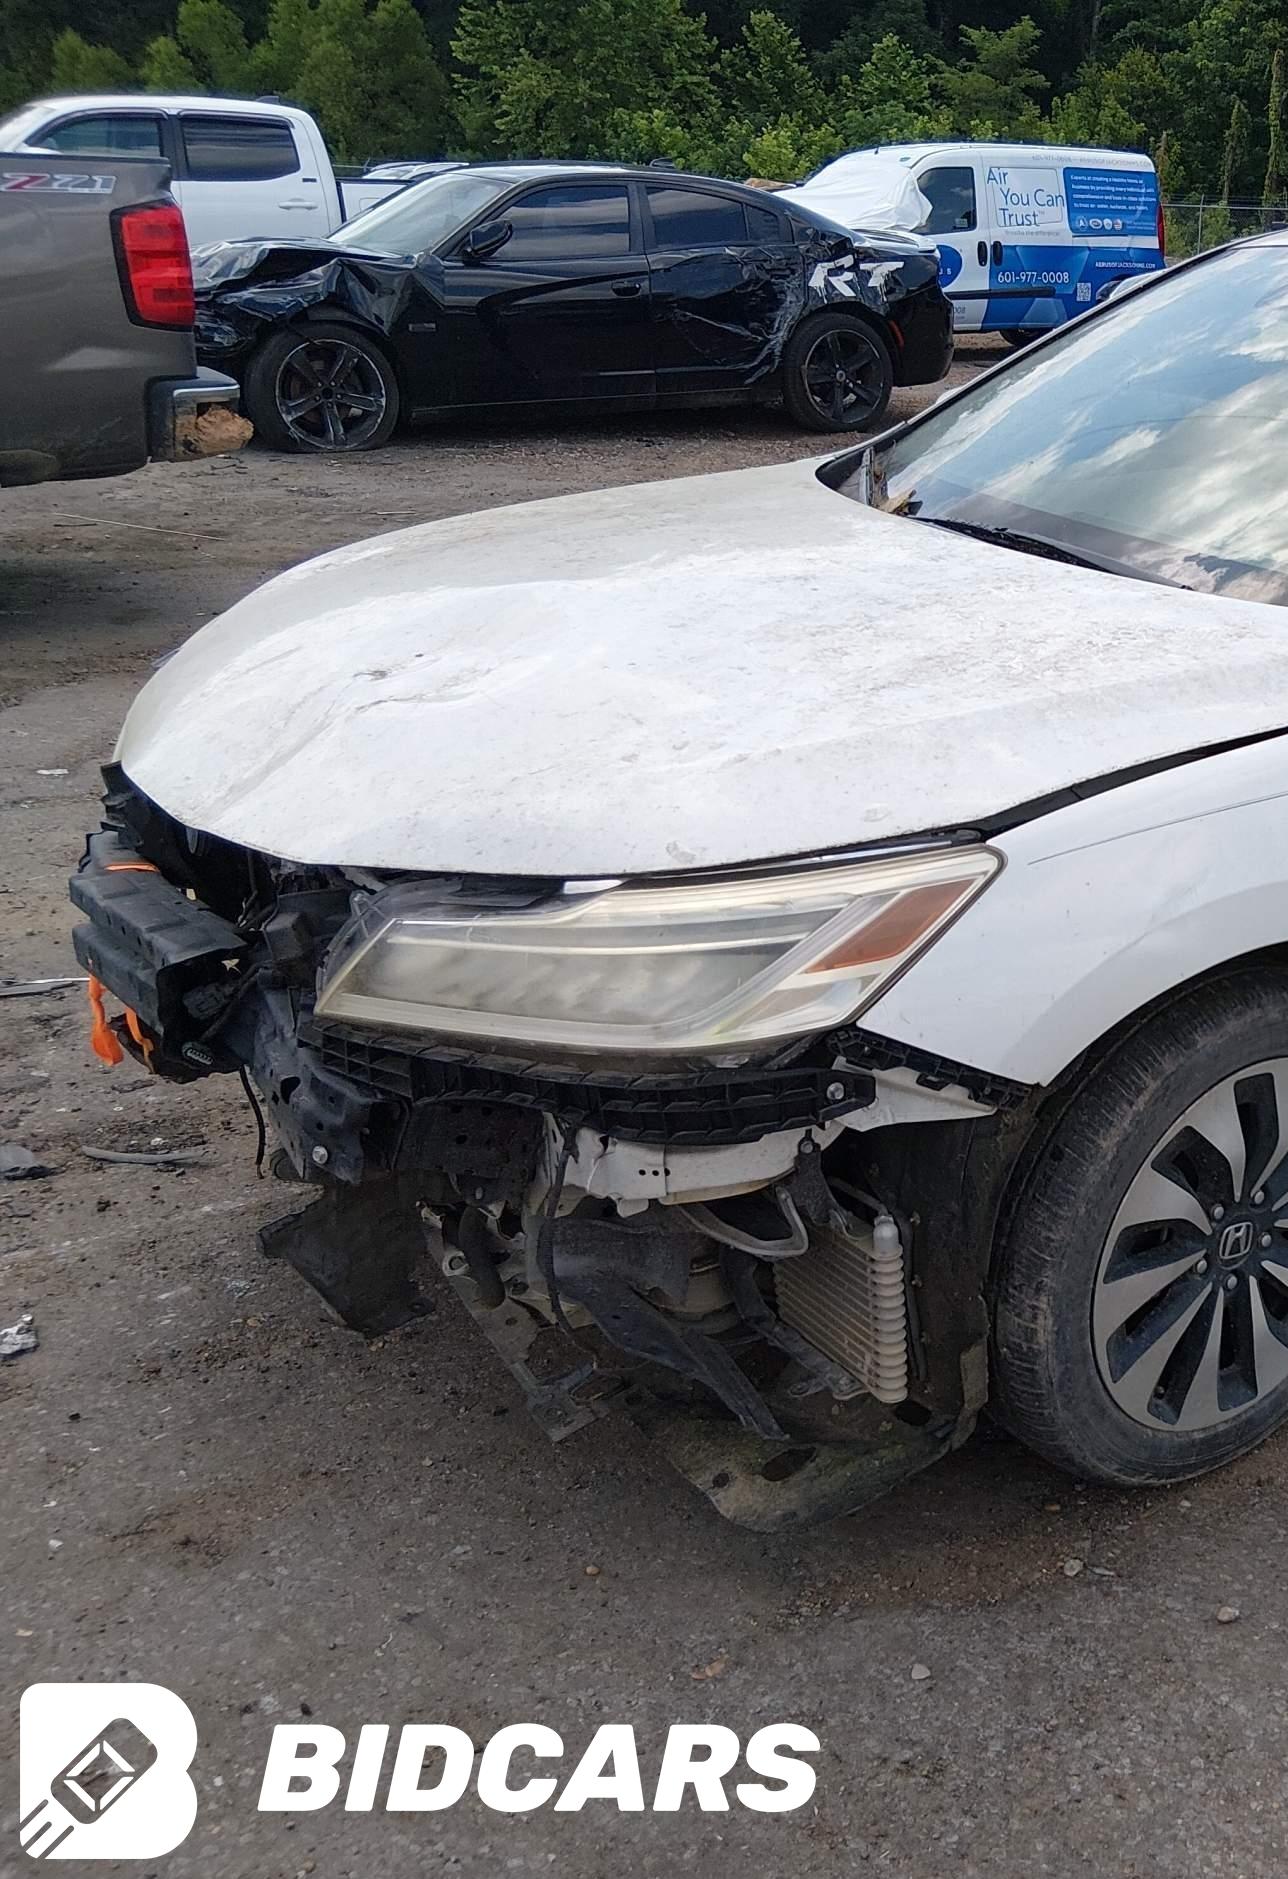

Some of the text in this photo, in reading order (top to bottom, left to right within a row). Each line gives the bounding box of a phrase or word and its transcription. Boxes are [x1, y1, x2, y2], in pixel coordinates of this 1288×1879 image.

[0, 172, 117, 194] Z71
[987, 167, 1008, 184] Air
[999, 188, 1030, 206] You
[1034, 188, 1065, 207] Can
[997, 271, 1070, 284] 601-977-0008
